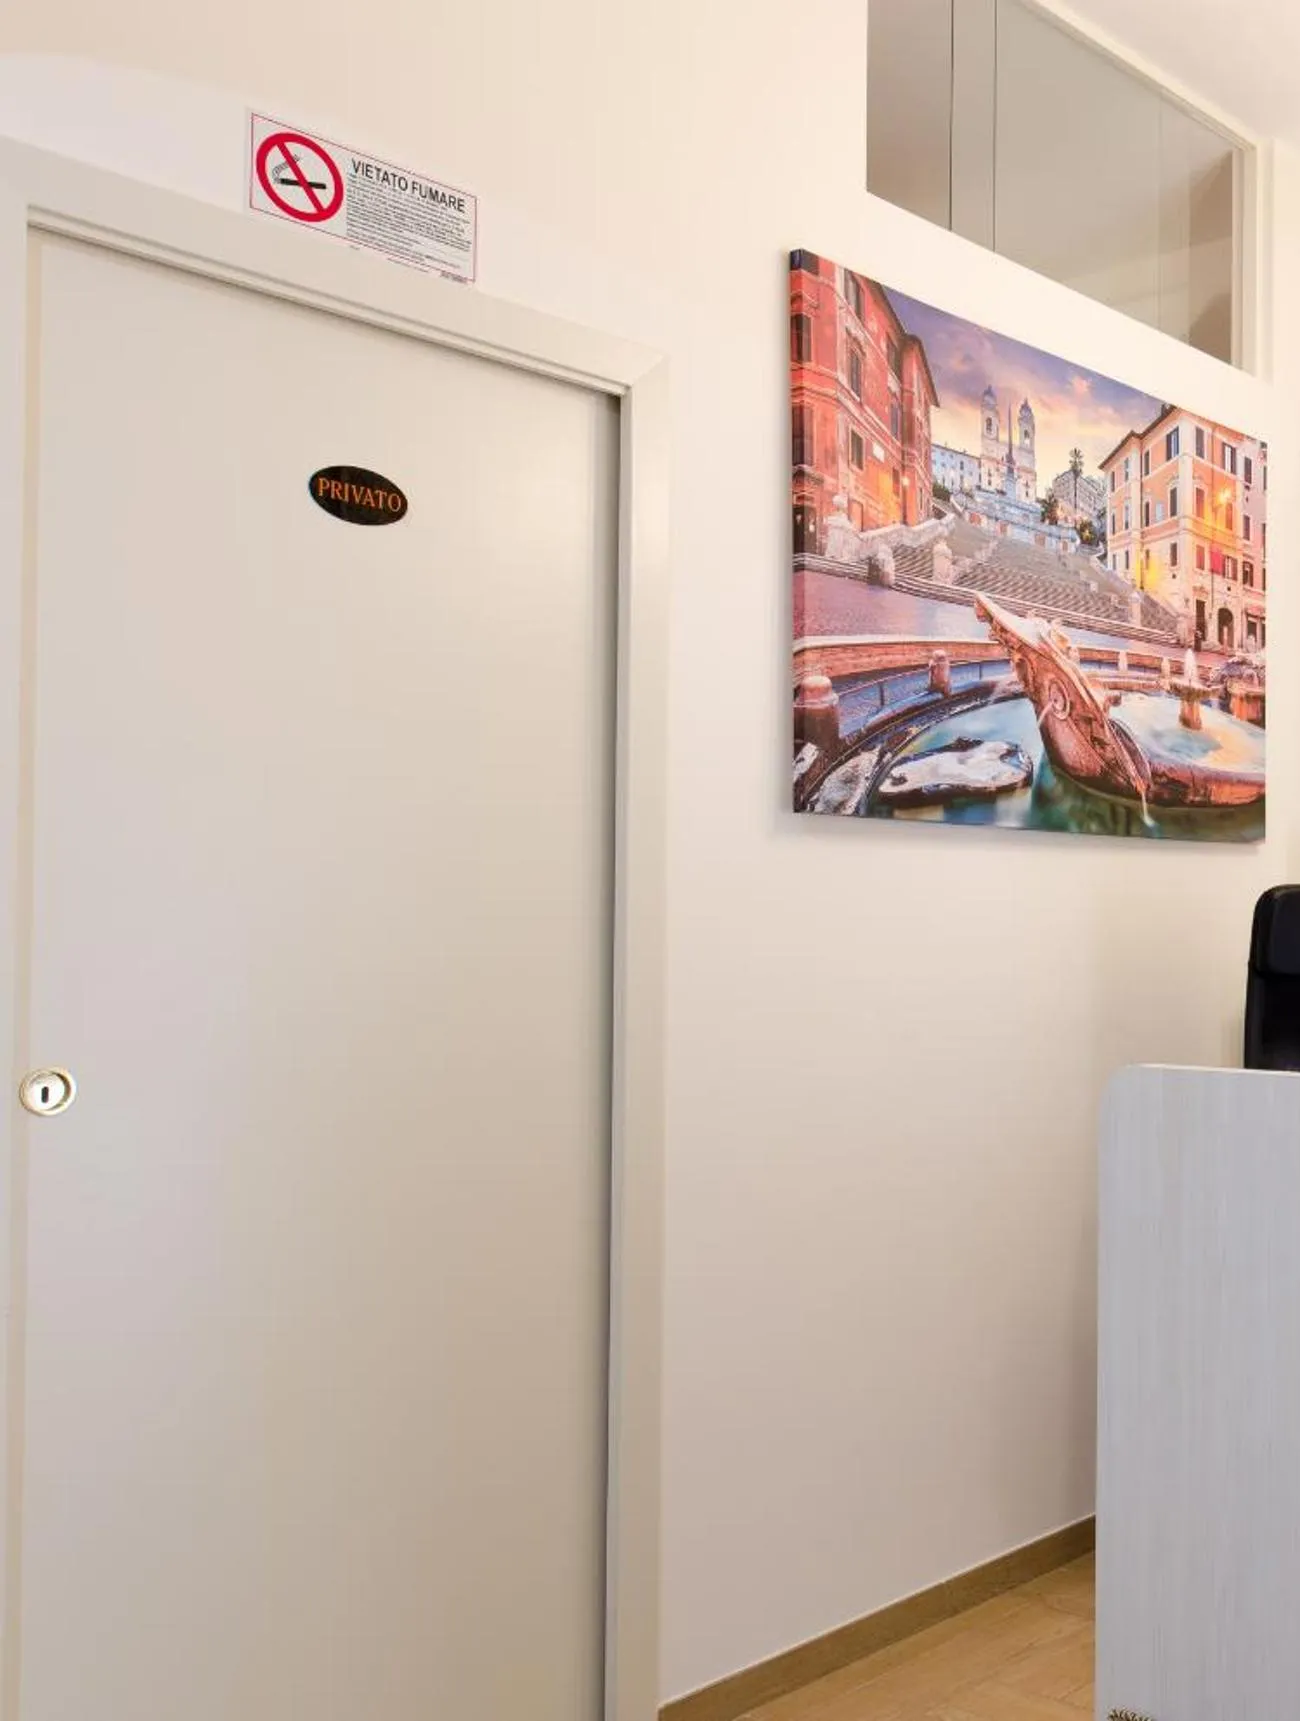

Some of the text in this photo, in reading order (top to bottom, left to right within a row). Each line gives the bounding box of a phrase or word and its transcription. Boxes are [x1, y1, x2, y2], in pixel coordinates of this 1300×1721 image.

[352, 158, 465, 212] VIETATO FUMARE
[318, 477, 401, 512] PRIVATO
